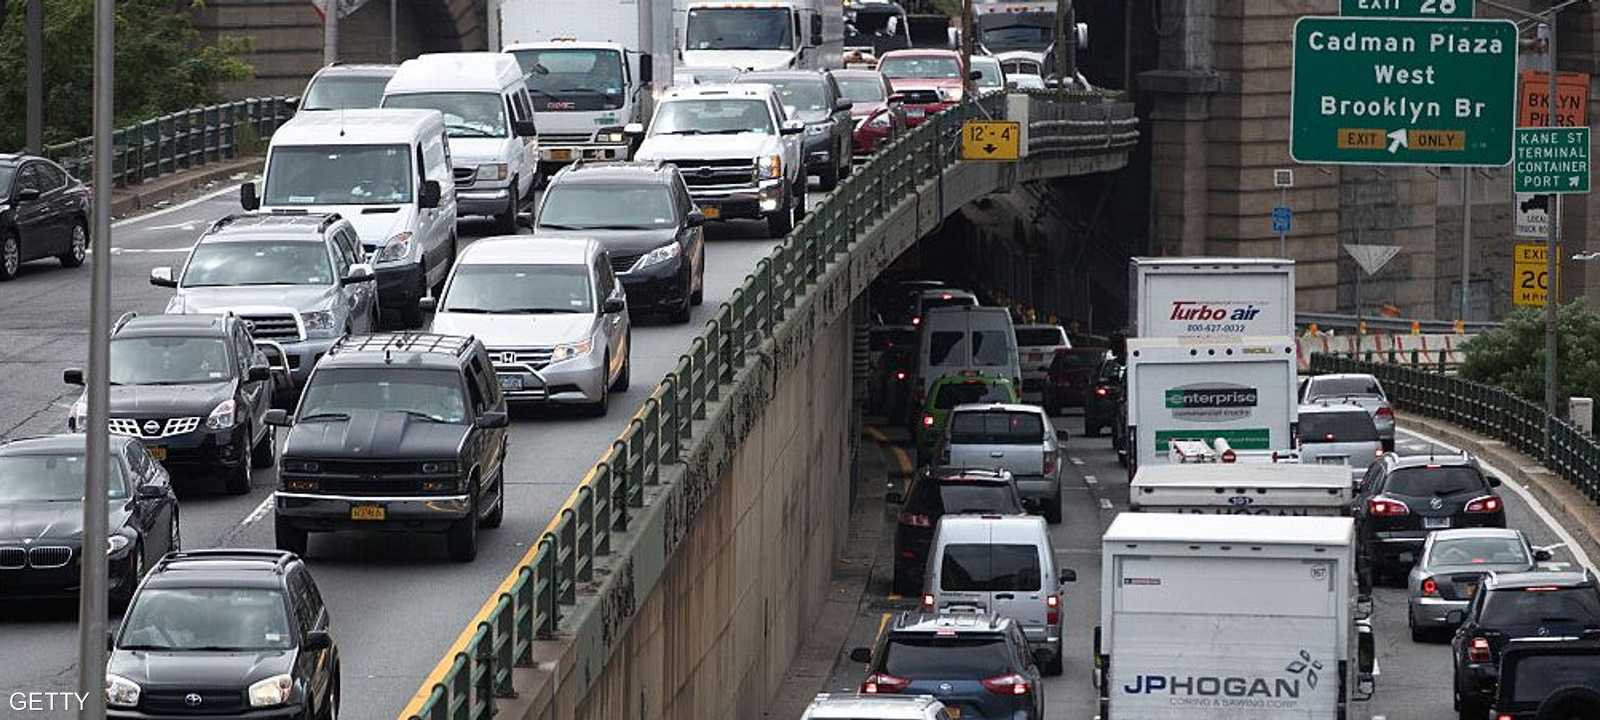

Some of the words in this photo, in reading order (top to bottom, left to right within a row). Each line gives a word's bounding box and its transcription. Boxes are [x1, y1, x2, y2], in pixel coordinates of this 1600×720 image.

[1358, 0, 1399, 9] EXIT
[1420, 0, 1456, 14] 28
[1308, 31, 1415, 52] Cadman
[1430, 33, 1503, 54] Plaza
[1374, 64, 1435, 84] West
[1529, 93, 1580, 109] BKYN
[1321, 96, 1440, 123] Brooklyn
[1455, 99, 1486, 118] Br
[1347, 133, 1377, 145] EXIT
[1418, 134, 1457, 147] ONLY
[1520, 132, 1558, 144] KANE
[1567, 132, 1584, 144] ST
[1518, 147, 1587, 158] TERMINAL
[1517, 161, 1587, 173] CONTAINER
[1523, 176, 1560, 187] PORT
[1524, 248, 1546, 259] EXI
[1170, 301, 1227, 321] Turbo
[1230, 305, 1260, 321] air
[1167, 391, 1256, 405] enterprise
